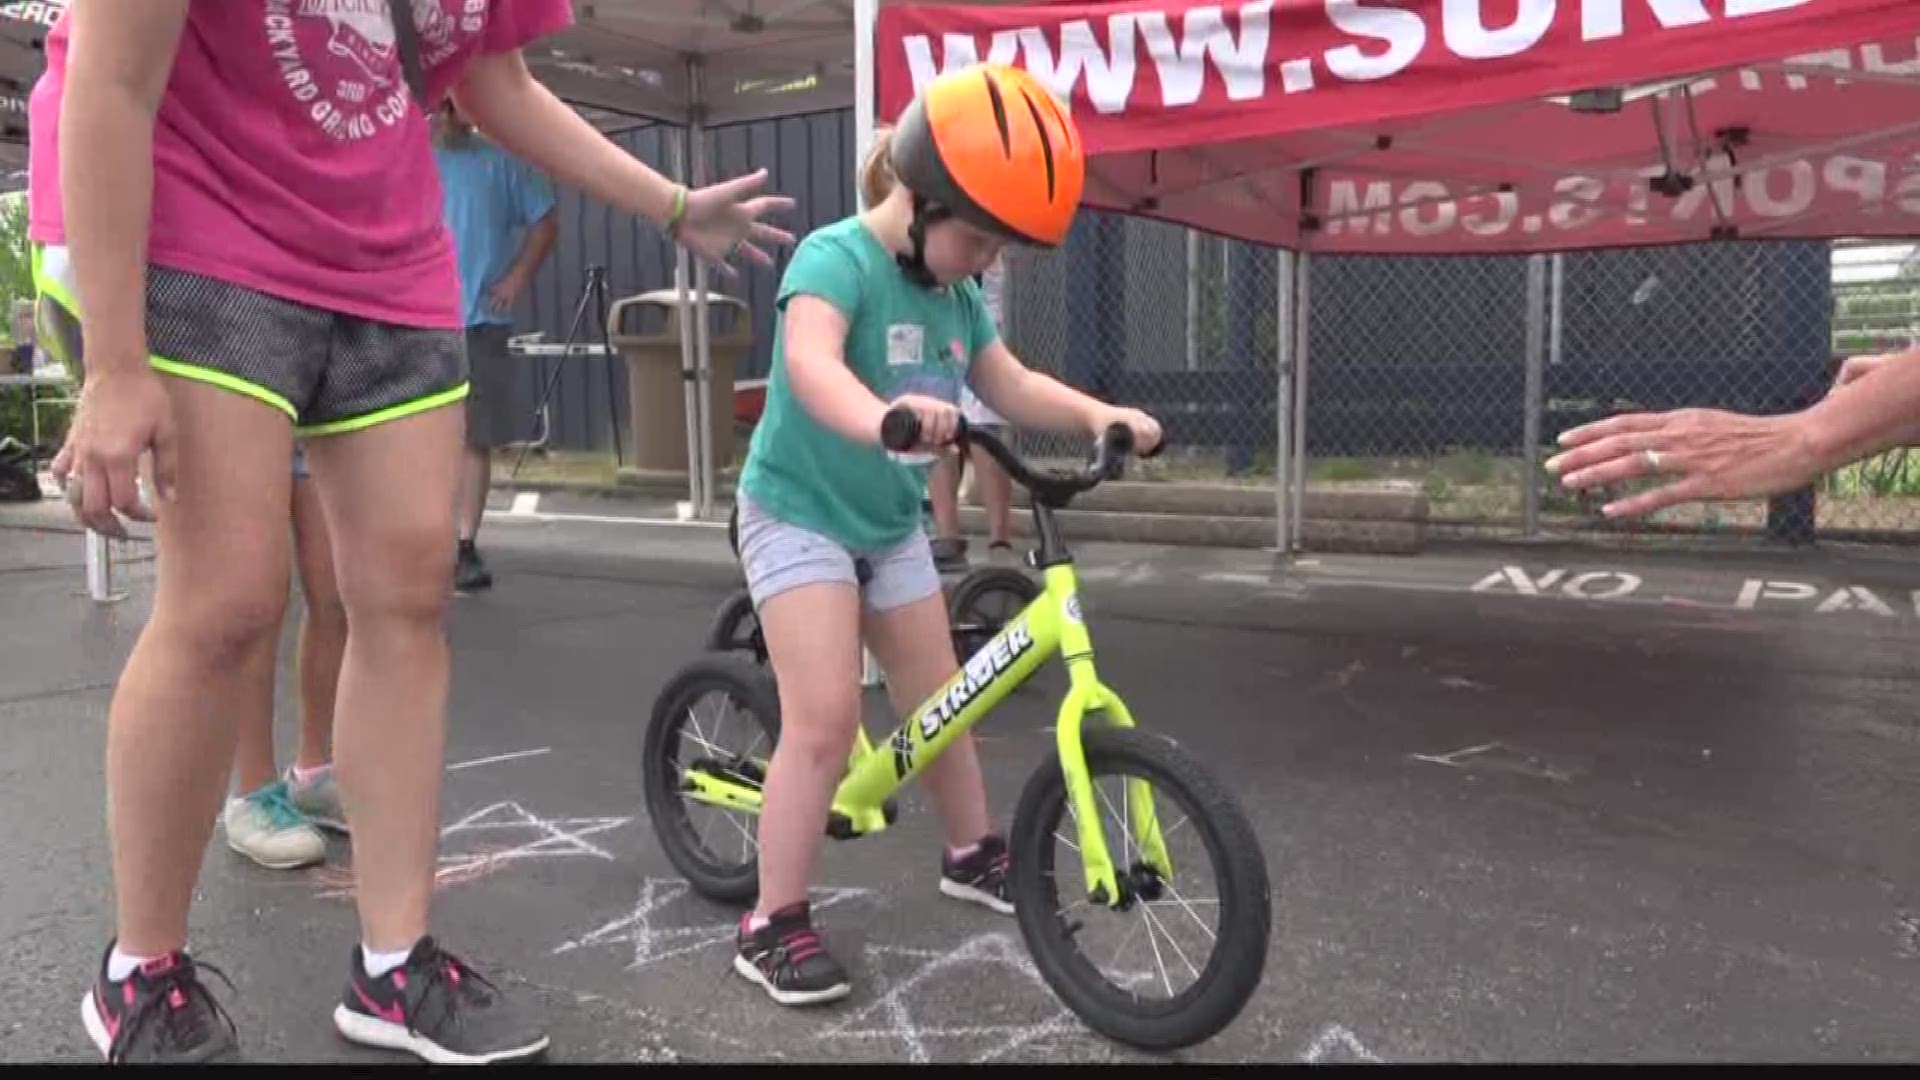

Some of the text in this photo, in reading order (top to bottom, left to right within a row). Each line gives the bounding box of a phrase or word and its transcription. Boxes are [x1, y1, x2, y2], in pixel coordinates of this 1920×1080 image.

[903, 0, 1808, 113] WWW.SU
[1470, 565, 1920, 618] NO PA
[919, 618, 1035, 741] STRIDER
